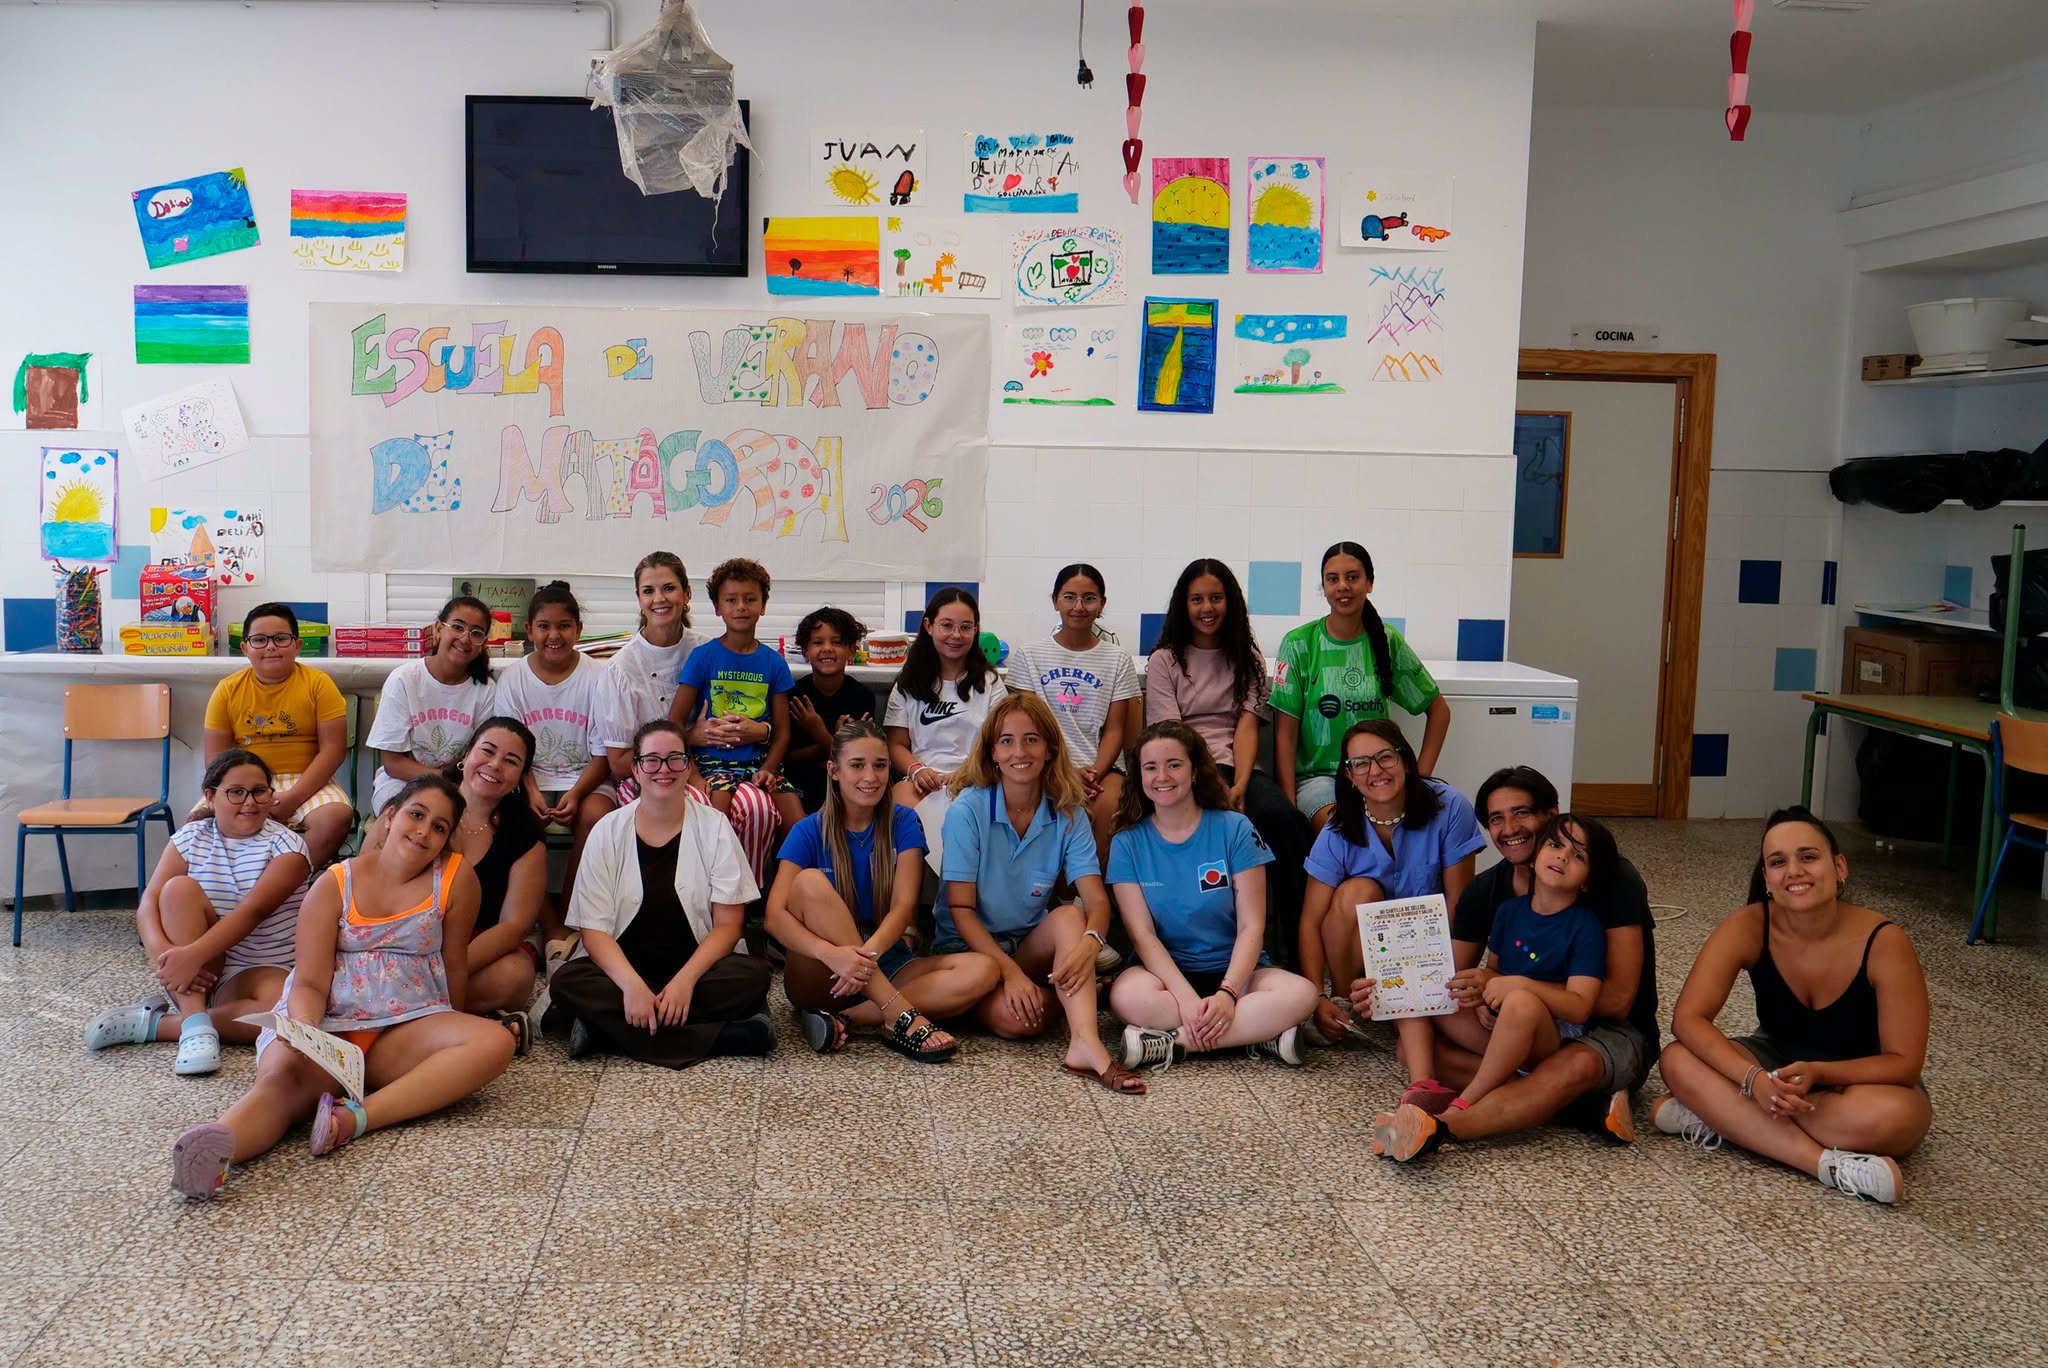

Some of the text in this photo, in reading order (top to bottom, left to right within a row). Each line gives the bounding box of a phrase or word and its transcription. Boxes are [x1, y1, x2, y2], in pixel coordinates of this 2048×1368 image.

[1595, 330, 1635, 342] COCINA
[351, 313, 940, 417] ESCUELA DE VERANO
[371, 425, 943, 543] DE MATAGORDA 2026
[485, 586, 525, 599] TANGA
[717, 670, 764, 683] MYSTERIOUS
[1040, 667, 1103, 689] CHERRY
[926, 701, 958, 718] NIKE
[1344, 699, 1385, 713] Spotify
